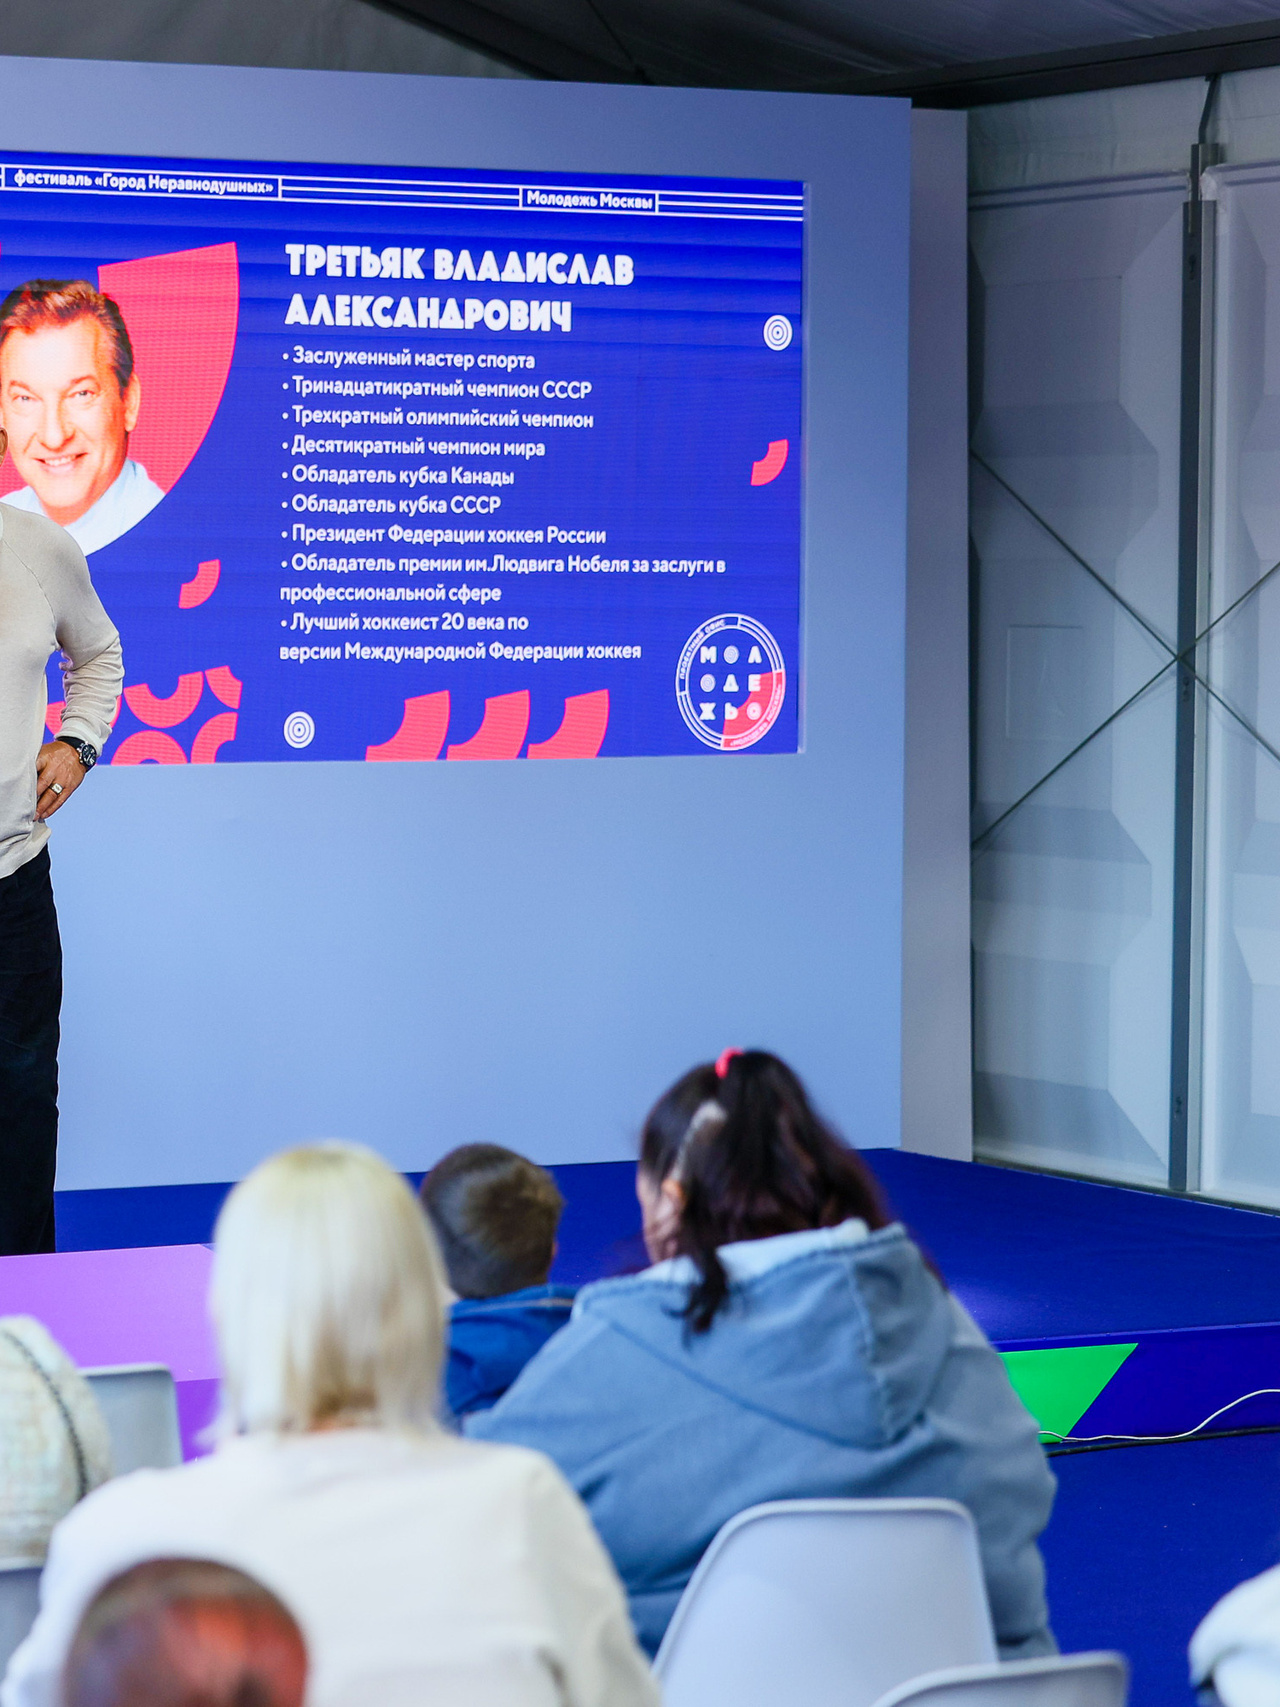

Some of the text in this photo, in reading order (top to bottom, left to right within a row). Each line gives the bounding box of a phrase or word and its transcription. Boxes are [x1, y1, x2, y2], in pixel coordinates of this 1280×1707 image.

[14, 169, 275, 195] фестиваль «Город Неравнодушных»
[527, 190, 652, 209] Молодежь Москвы
[286, 244, 633, 285] ТРЕТЬЯК ВЛАДИСЛАВ
[285, 294, 571, 332] АЛЕКСАНДРОВИЧ
[293, 345, 535, 372] Заслуженный мастер спорта
[292, 376, 592, 399] Тринадцатикратный чемпион СССР
[292, 405, 593, 427] Трехкратный олимпийский чемпион
[292, 435, 545, 460] Десятикратный чемпион мира
[292, 464, 514, 487] Обладатель кубка Канады
[292, 494, 501, 517] Обладатель кубка СССР
[293, 524, 606, 546] Президент Федерации хоккея России
[292, 553, 395, 573] Обладатель
[399, 559, 462, 575] премии
[568, 555, 629, 572] Нобеля
[632, 560, 649, 572] за
[652, 560, 713, 577] заслуги
[717, 560, 725, 572] в
[281, 583, 501, 605] профессиональной сфере
[290, 612, 528, 634] Лучший хоккеист 20 века по
[280, 642, 641, 664] версии Международной Федерации хоккея
